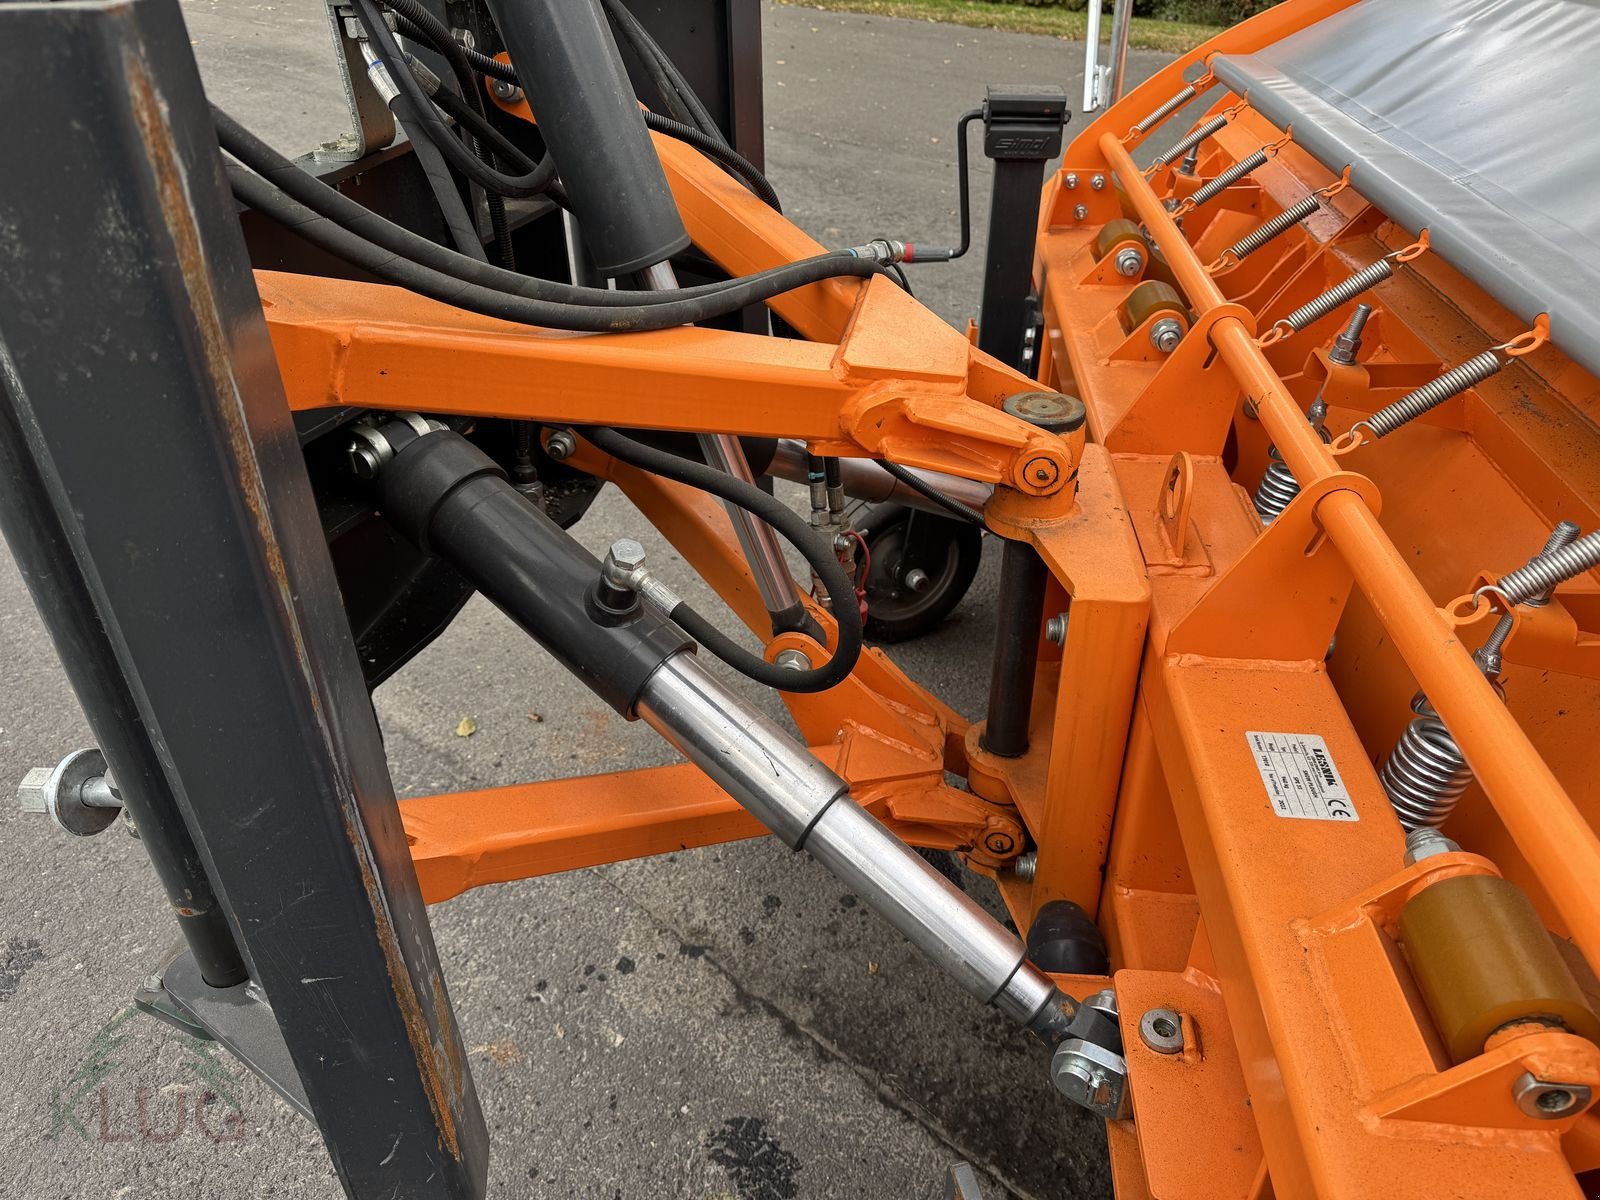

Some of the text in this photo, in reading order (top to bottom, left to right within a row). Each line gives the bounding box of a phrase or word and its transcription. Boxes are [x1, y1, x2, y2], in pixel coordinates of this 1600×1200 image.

[1312, 749, 1337, 786] LESNIK
[1302, 770, 1311, 782] SNOW
[1308, 783, 1318, 798] PLOUGH
